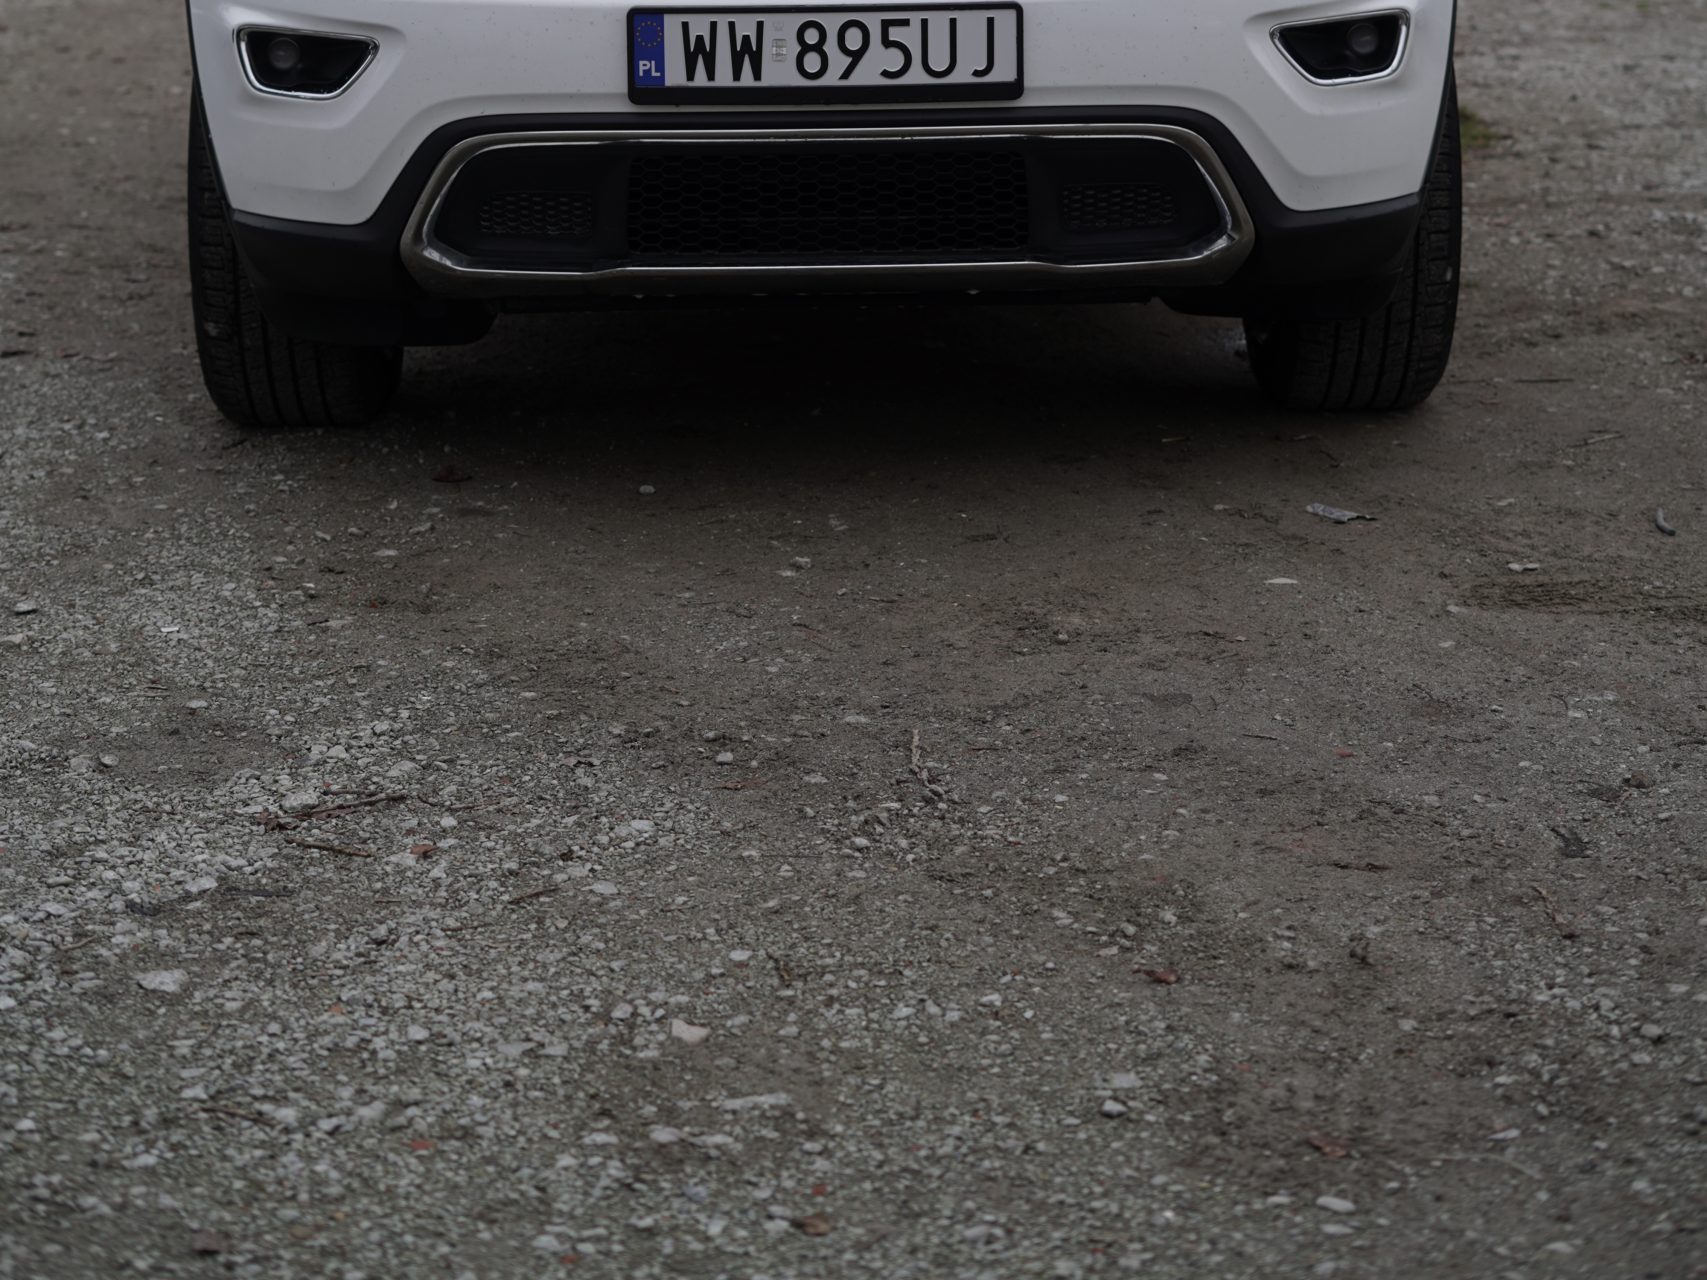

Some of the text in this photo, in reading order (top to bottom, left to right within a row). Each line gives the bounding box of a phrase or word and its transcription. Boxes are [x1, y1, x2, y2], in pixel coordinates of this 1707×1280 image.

[638, 60, 661, 77] PL
[681, 17, 994, 81] WW 895UJ
